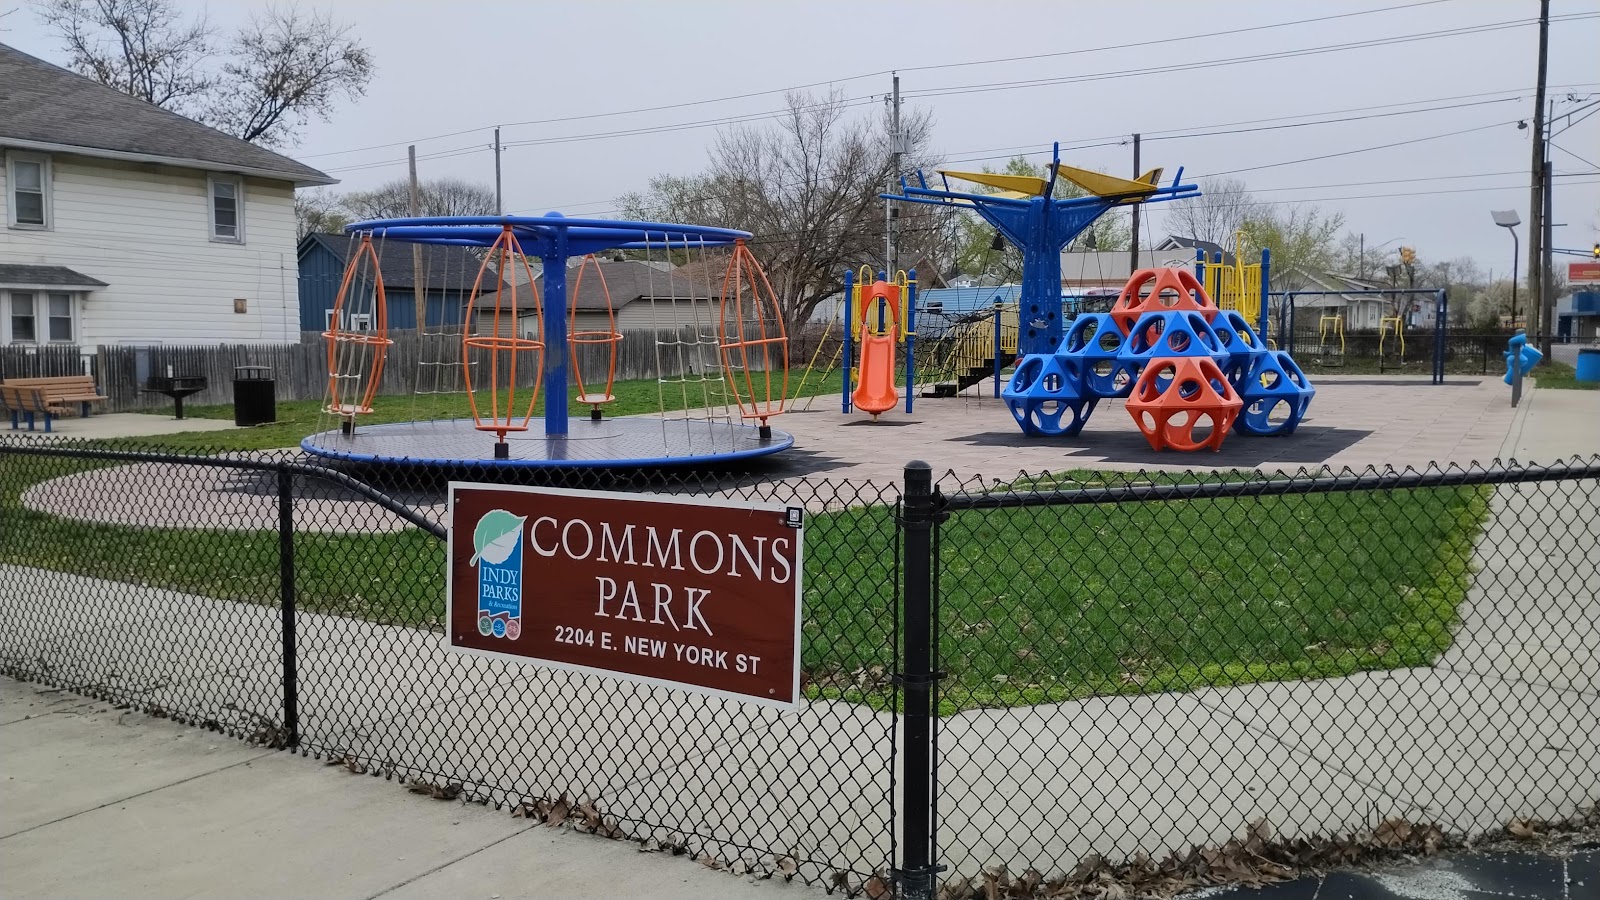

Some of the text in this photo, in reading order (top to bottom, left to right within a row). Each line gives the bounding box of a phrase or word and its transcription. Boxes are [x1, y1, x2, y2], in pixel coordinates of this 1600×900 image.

[530, 516, 791, 584] COMMONS
[482, 566, 519, 585] INDY
[482, 583, 519, 602] PARKS
[594, 576, 713, 637] PARK
[554, 625, 761, 675] 2204 E. NEW YORK ST
